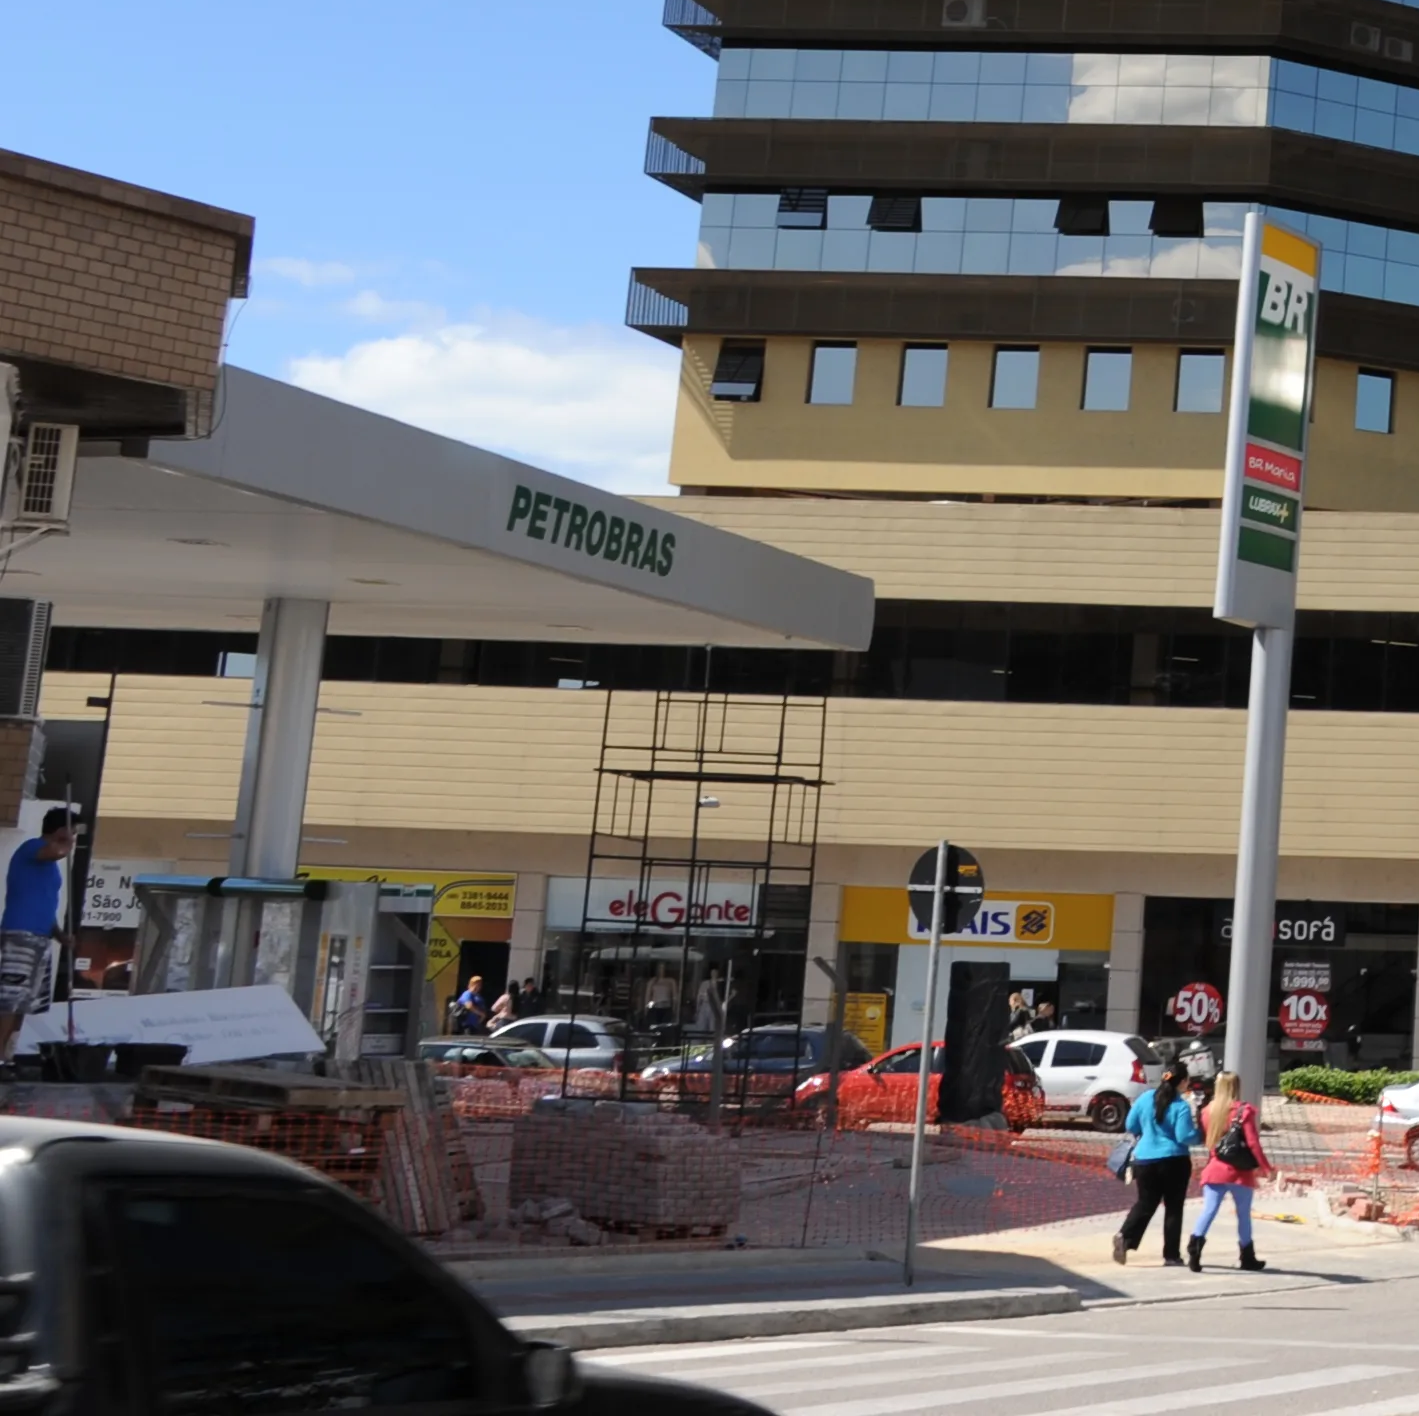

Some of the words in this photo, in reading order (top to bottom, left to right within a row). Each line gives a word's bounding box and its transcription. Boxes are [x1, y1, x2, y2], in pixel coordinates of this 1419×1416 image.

[1260, 274, 1308, 335] BR
[506, 484, 676, 577] PETROBRAS
[91, 893, 122, 909] São
[608, 889, 750, 930] eleGante
[1175, 990, 1220, 1023] 50%
[1283, 995, 1328, 1021] 10x
